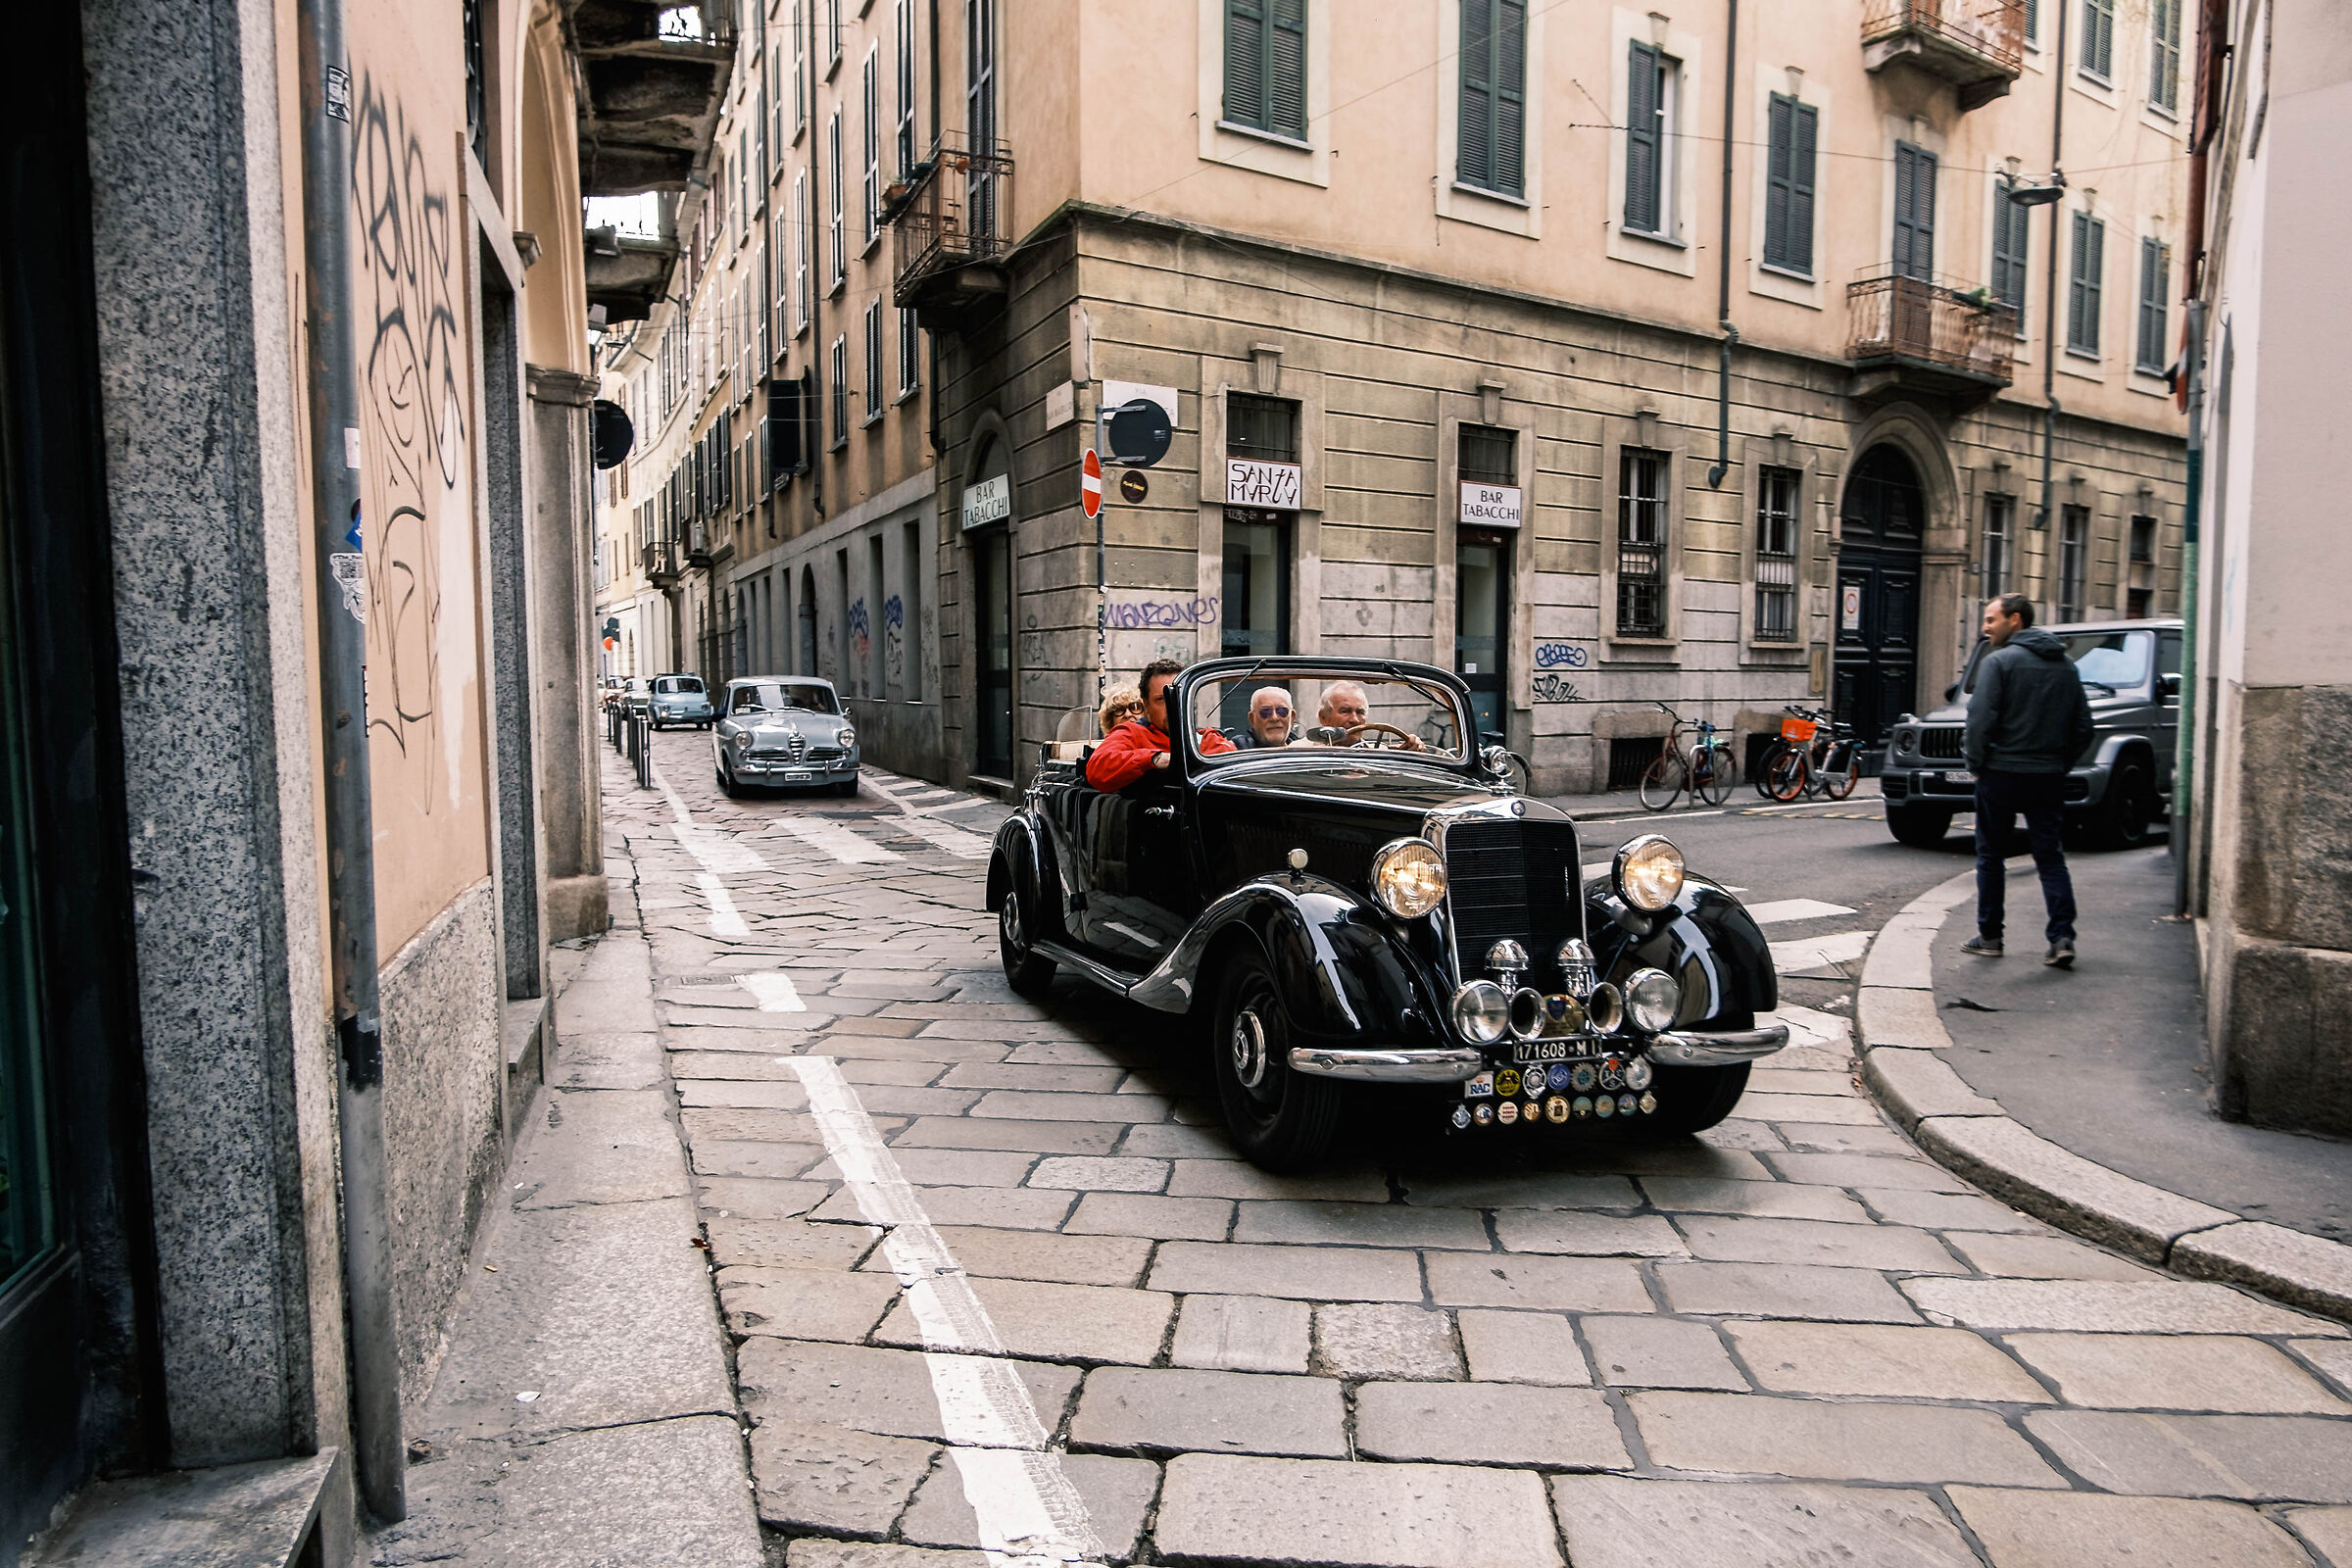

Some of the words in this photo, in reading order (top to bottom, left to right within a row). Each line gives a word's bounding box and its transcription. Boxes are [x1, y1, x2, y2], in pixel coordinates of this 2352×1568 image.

[976, 480, 995, 504] BAR
[1481, 490, 1503, 504] BAR
[964, 496, 1007, 527] TABACCHI
[1462, 503, 1520, 520] TABACCHI
[1518, 1042, 1566, 1059] 171608
[1470, 1083, 1491, 1095] RAC
